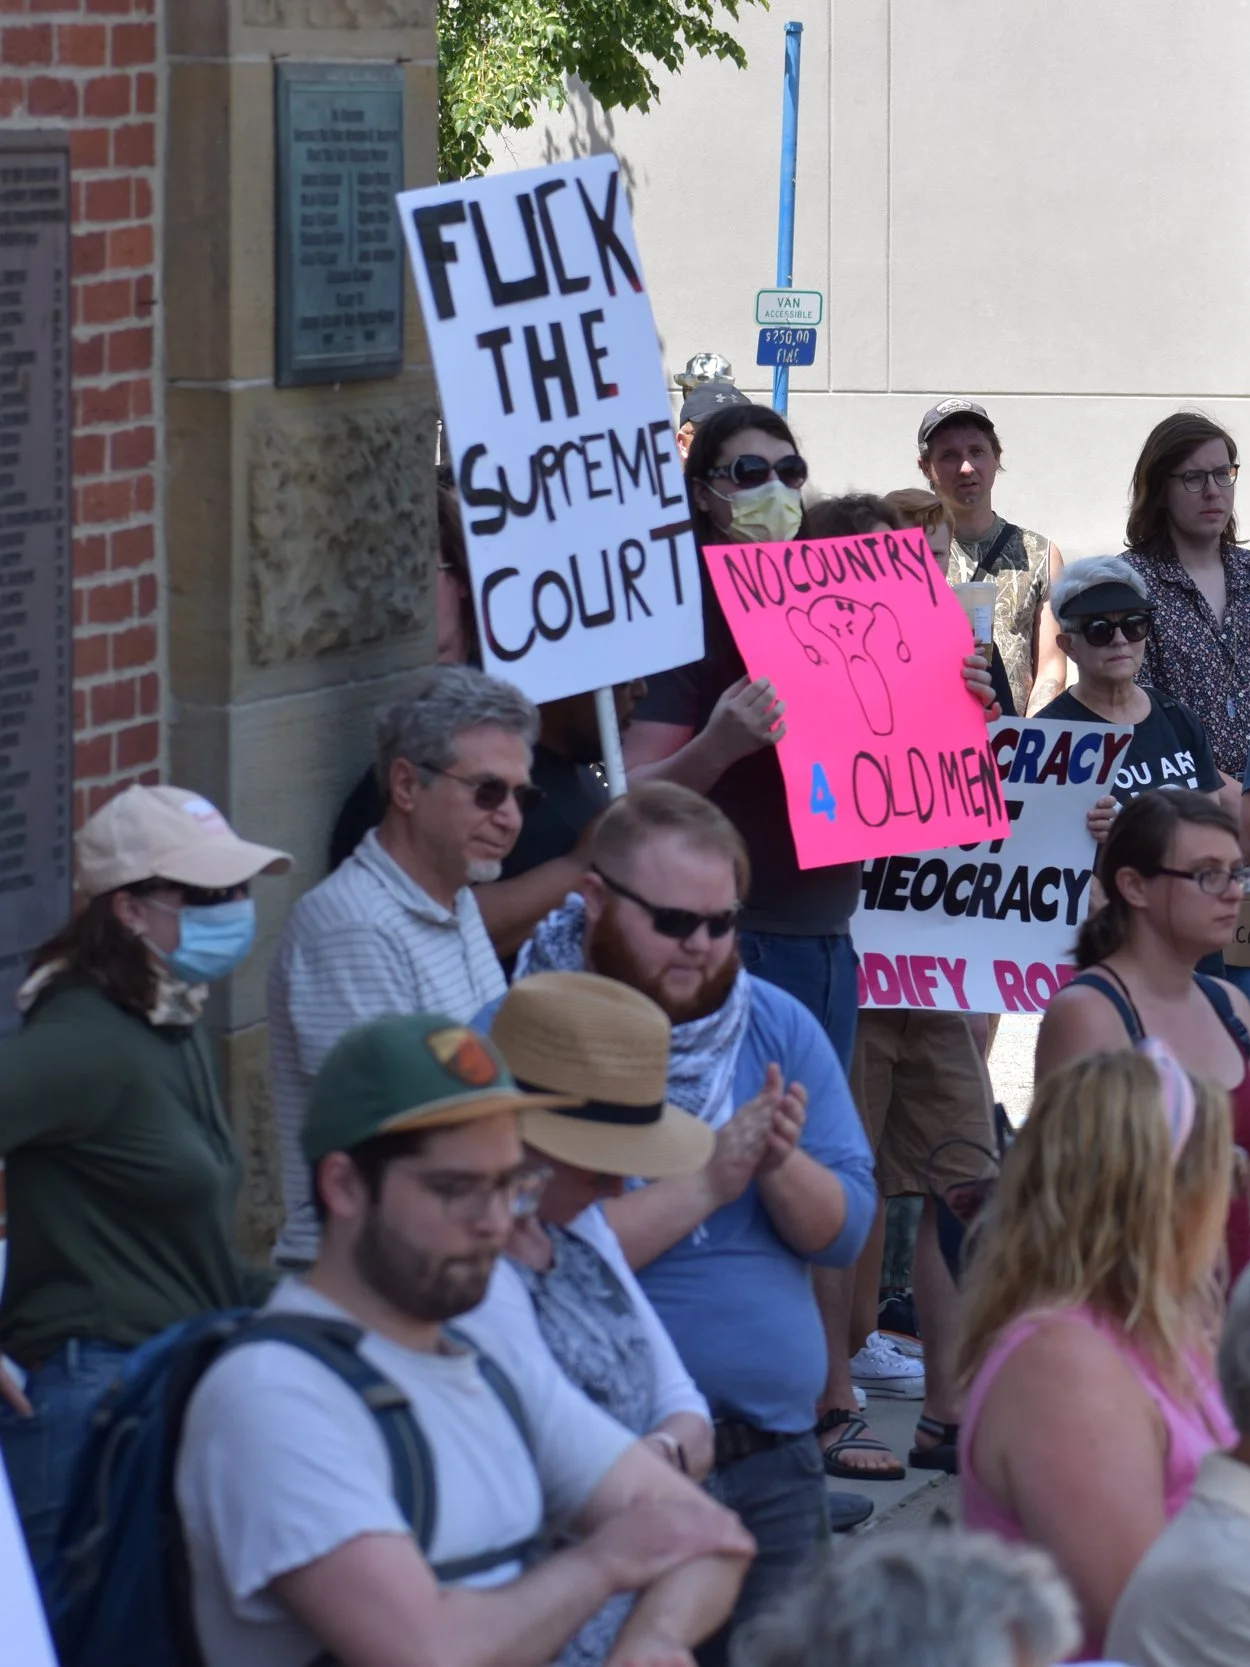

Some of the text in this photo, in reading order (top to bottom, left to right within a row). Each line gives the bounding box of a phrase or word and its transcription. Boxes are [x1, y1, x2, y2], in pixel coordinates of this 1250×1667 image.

[412, 170, 643, 320] FUCK
[765, 310, 812, 319] ACCESSIBLE
[777, 298, 800, 308] VAN
[476, 309, 618, 422] THE
[460, 420, 683, 536] SUPREME
[483, 522, 692, 661] COURT
[810, 763, 836, 822] 4
[852, 747, 935, 827] OLD
[939, 740, 1002, 827] MEN
[990, 728, 1133, 785] CRACY
[1114, 761, 1152, 789] OU
[860, 855, 1093, 925] HEOCRACY
